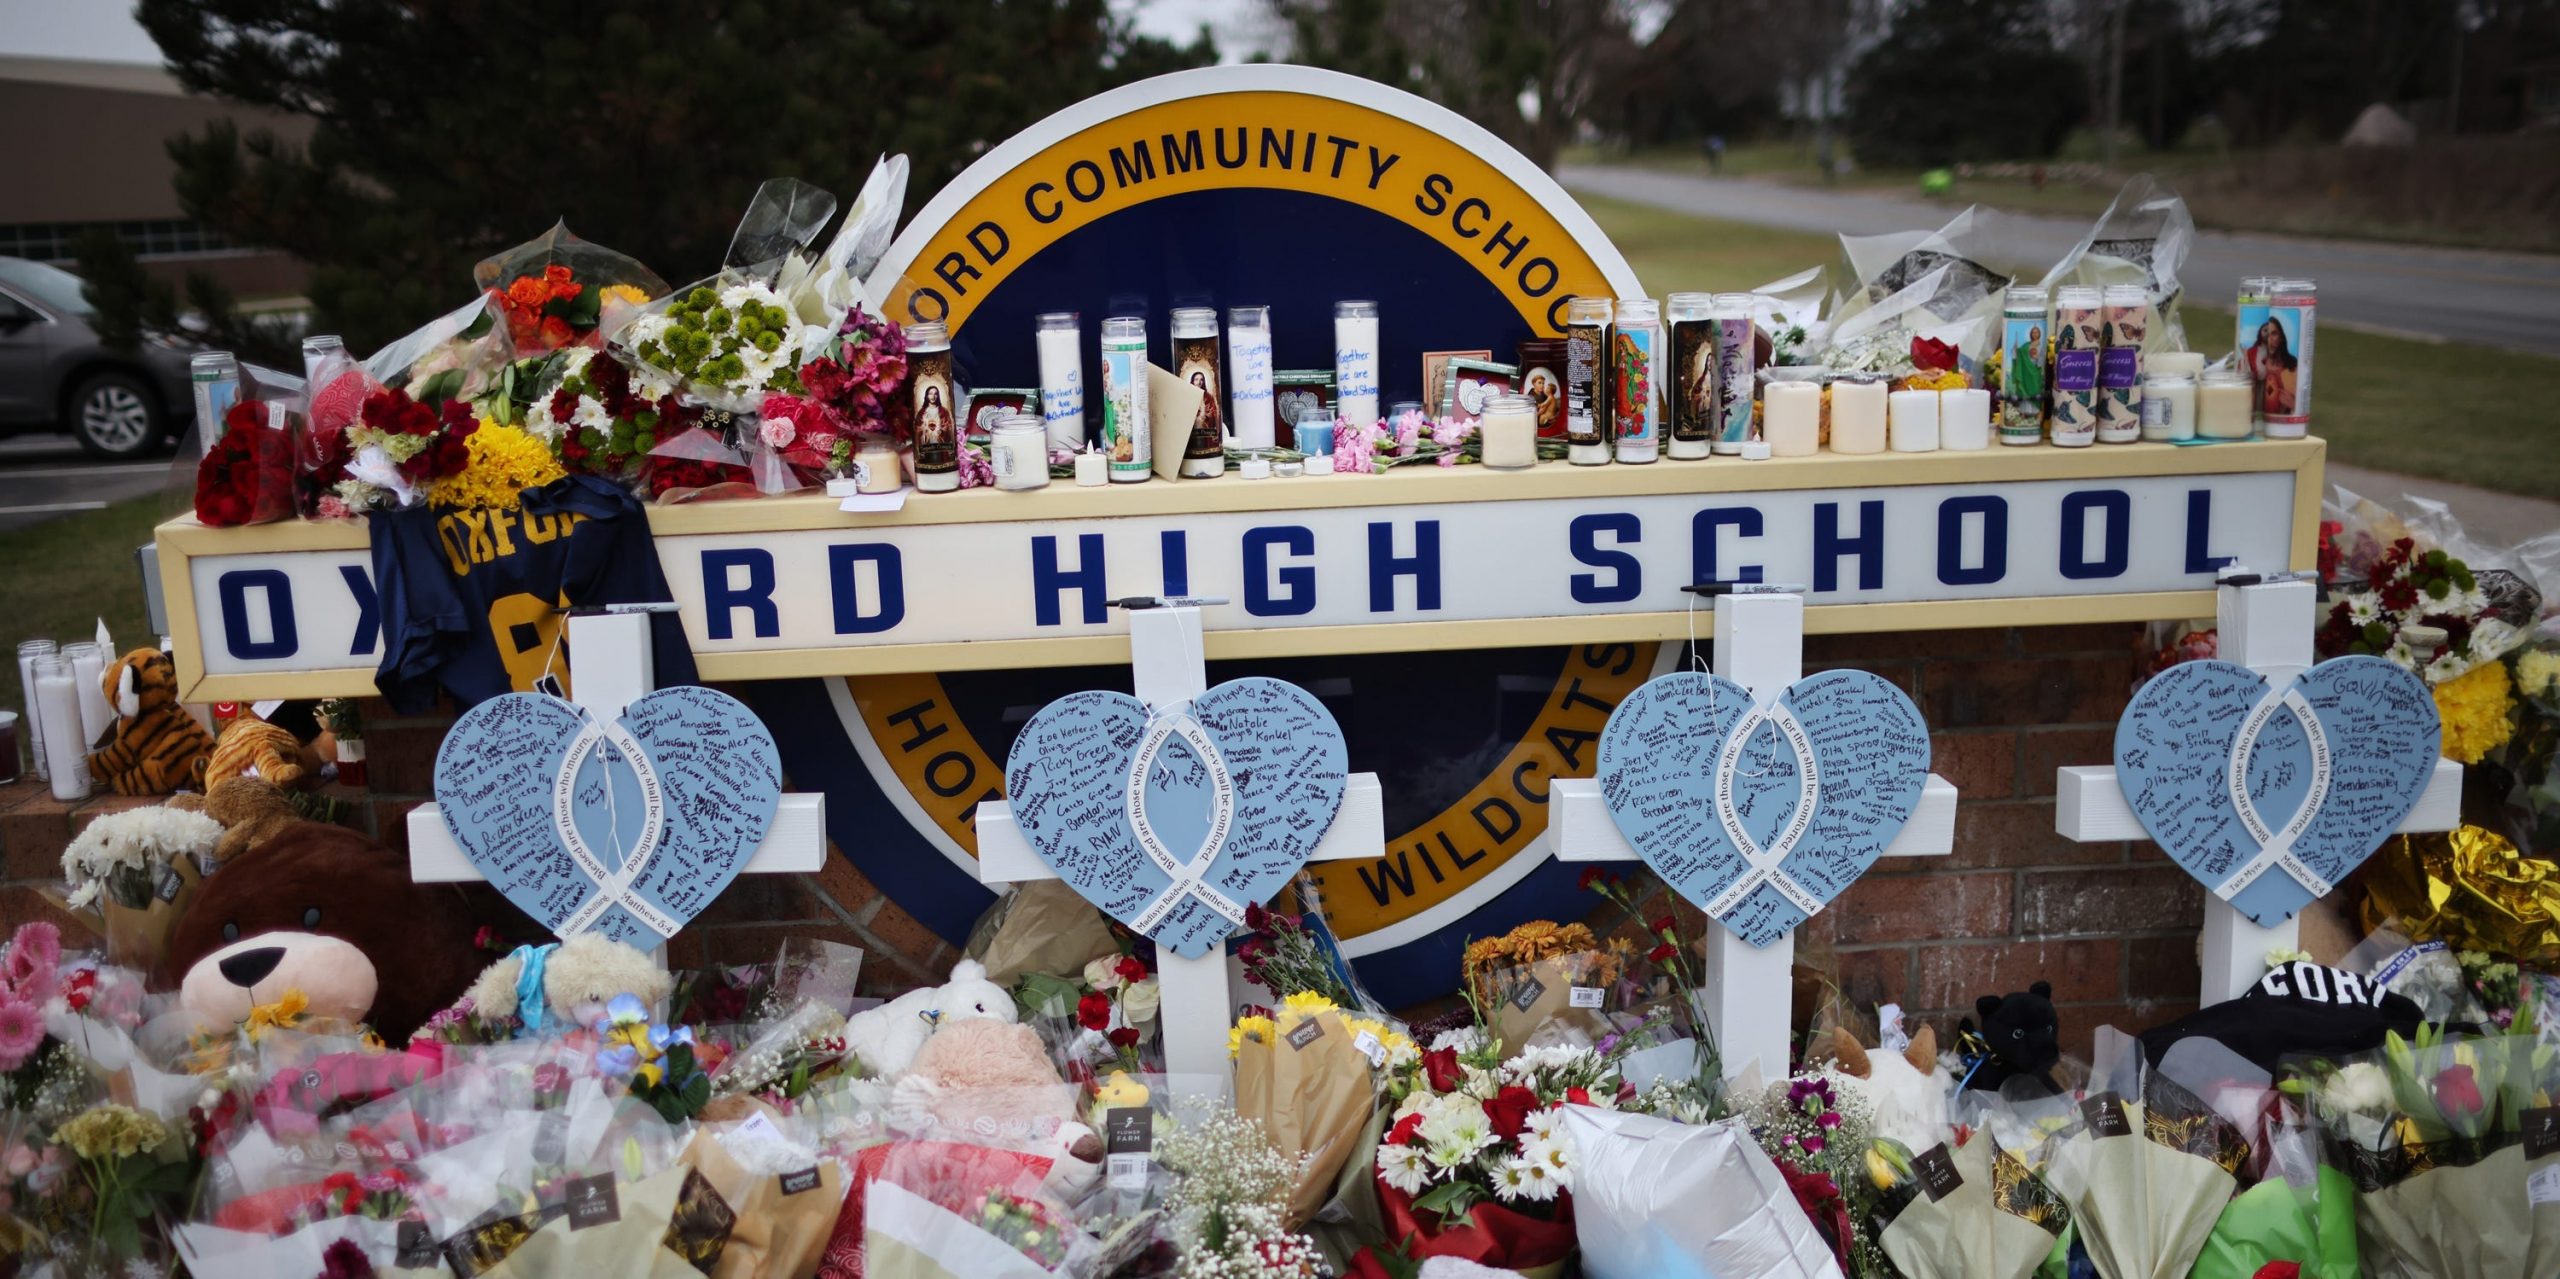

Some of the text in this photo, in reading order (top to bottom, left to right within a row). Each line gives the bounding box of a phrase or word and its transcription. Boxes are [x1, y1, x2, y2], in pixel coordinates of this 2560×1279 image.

[1025, 127, 1400, 225] COMMUNITY
[1245, 373, 1264, 381] are
[1353, 369, 1369, 380] are
[1031, 519, 1442, 627] HIGH
[1569, 488, 2239, 604] SCHOOL
[1799, 695, 1831, 713] Natalie
[651, 709, 682, 728] Konkel
[1229, 716, 1268, 729] Natalie
[1609, 699, 1636, 734] Cameron
[2247, 703, 2276, 736] mourn,
[621, 738, 635, 753] for
[728, 737, 749, 750] Alex
[1188, 729, 1204, 746] for
[1256, 730, 1292, 741] Konkel
[1883, 729, 1927, 745] Rochester
[567, 736, 593, 768] mourn,
[1224, 747, 1262, 756] Annabelle
[1724, 744, 1738, 770] who
[1823, 751, 1889, 768] Alyssa Pusey
[1880, 740, 1925, 760] University
[2235, 736, 2250, 761] who
[632, 751, 649, 775] they
[1036, 745, 1109, 777] Ricky Green
[1623, 756, 1641, 767] Joey
[2289, 706, 2329, 836] for they shall be comforted.
[2337, 765, 2364, 775] Caleb
[497, 761, 532, 786] Smiley
[559, 768, 571, 790] who
[1132, 763, 1145, 785] who
[1215, 768, 1230, 792] shall
[1356, 642, 1636, 905] WILDCATS
[1628, 776, 1657, 788] Caleb
[1779, 717, 1816, 851] for they shall be comforted.
[2233, 761, 2245, 792] those
[644, 774, 660, 804] shall
[1719, 771, 1730, 802] those
[560, 792, 569, 827] those
[1056, 799, 1084, 817] Caleb
[1131, 788, 1141, 821] those
[1221, 792, 1230, 806] be
[1676, 796, 1703, 811] Smiley
[1723, 801, 1734, 819] are
[2238, 792, 2249, 810] are
[471, 804, 506, 825] Caleb
[651, 805, 660, 818] be
[1066, 800, 1124, 832] Brendan Smiley
[481, 823, 512, 848] Ricky
[514, 804, 545, 827] Green
[566, 829, 579, 846] are
[1088, 822, 1122, 851] RYAN
[1138, 822, 1151, 837] are
[1200, 806, 1229, 862] comforted.
[1634, 830, 1655, 845] Bella
[1726, 819, 1755, 857] Blessed
[2242, 809, 2270, 843] Blessed
[573, 847, 607, 881] Blessed
[1145, 838, 1175, 872] Blessed
[1652, 849, 1668, 863] Ava
[2244, 861, 2264, 878] Myre
[2280, 854, 2326, 895] Matthew 5:4
[1193, 882, 1246, 923] Matthew 5:4
[1709, 899, 1731, 917] Hana
[1738, 868, 1766, 893] Juliana
[1769, 870, 1817, 913] Matthew 5:4
[565, 914, 586, 936] Justin
[584, 893, 611, 918] Shilling
[621, 892, 673, 935] Matthew 5:4
[1136, 878, 1191, 931] Madisyn Baldwin
[2099, 1119, 2119, 1127] FARM
[1933, 1175, 1950, 1188] FARM
